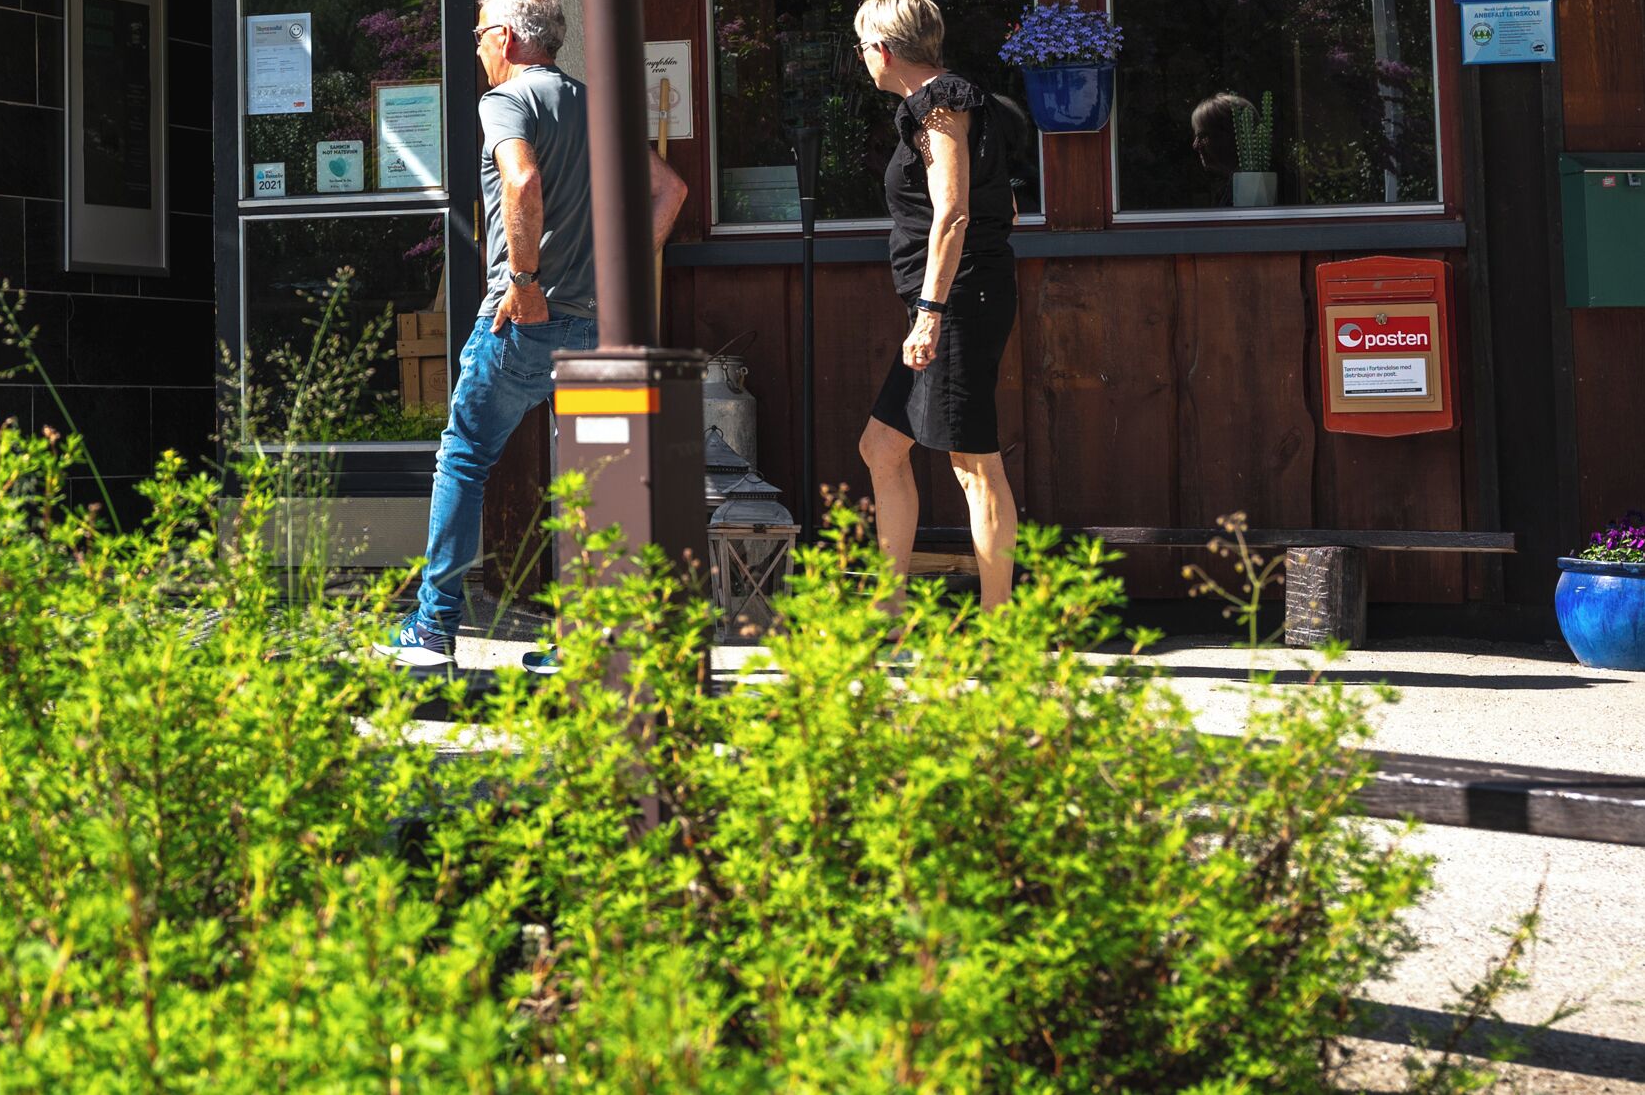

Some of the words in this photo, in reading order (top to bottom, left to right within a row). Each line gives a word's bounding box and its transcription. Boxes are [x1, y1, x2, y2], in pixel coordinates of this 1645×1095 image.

[1474, 11, 1505, 19] ANBEFALT
[1506, 9, 1540, 17] LEIRSKOLE
[259, 180, 281, 191] 2021
[1365, 330, 1428, 349] posten
